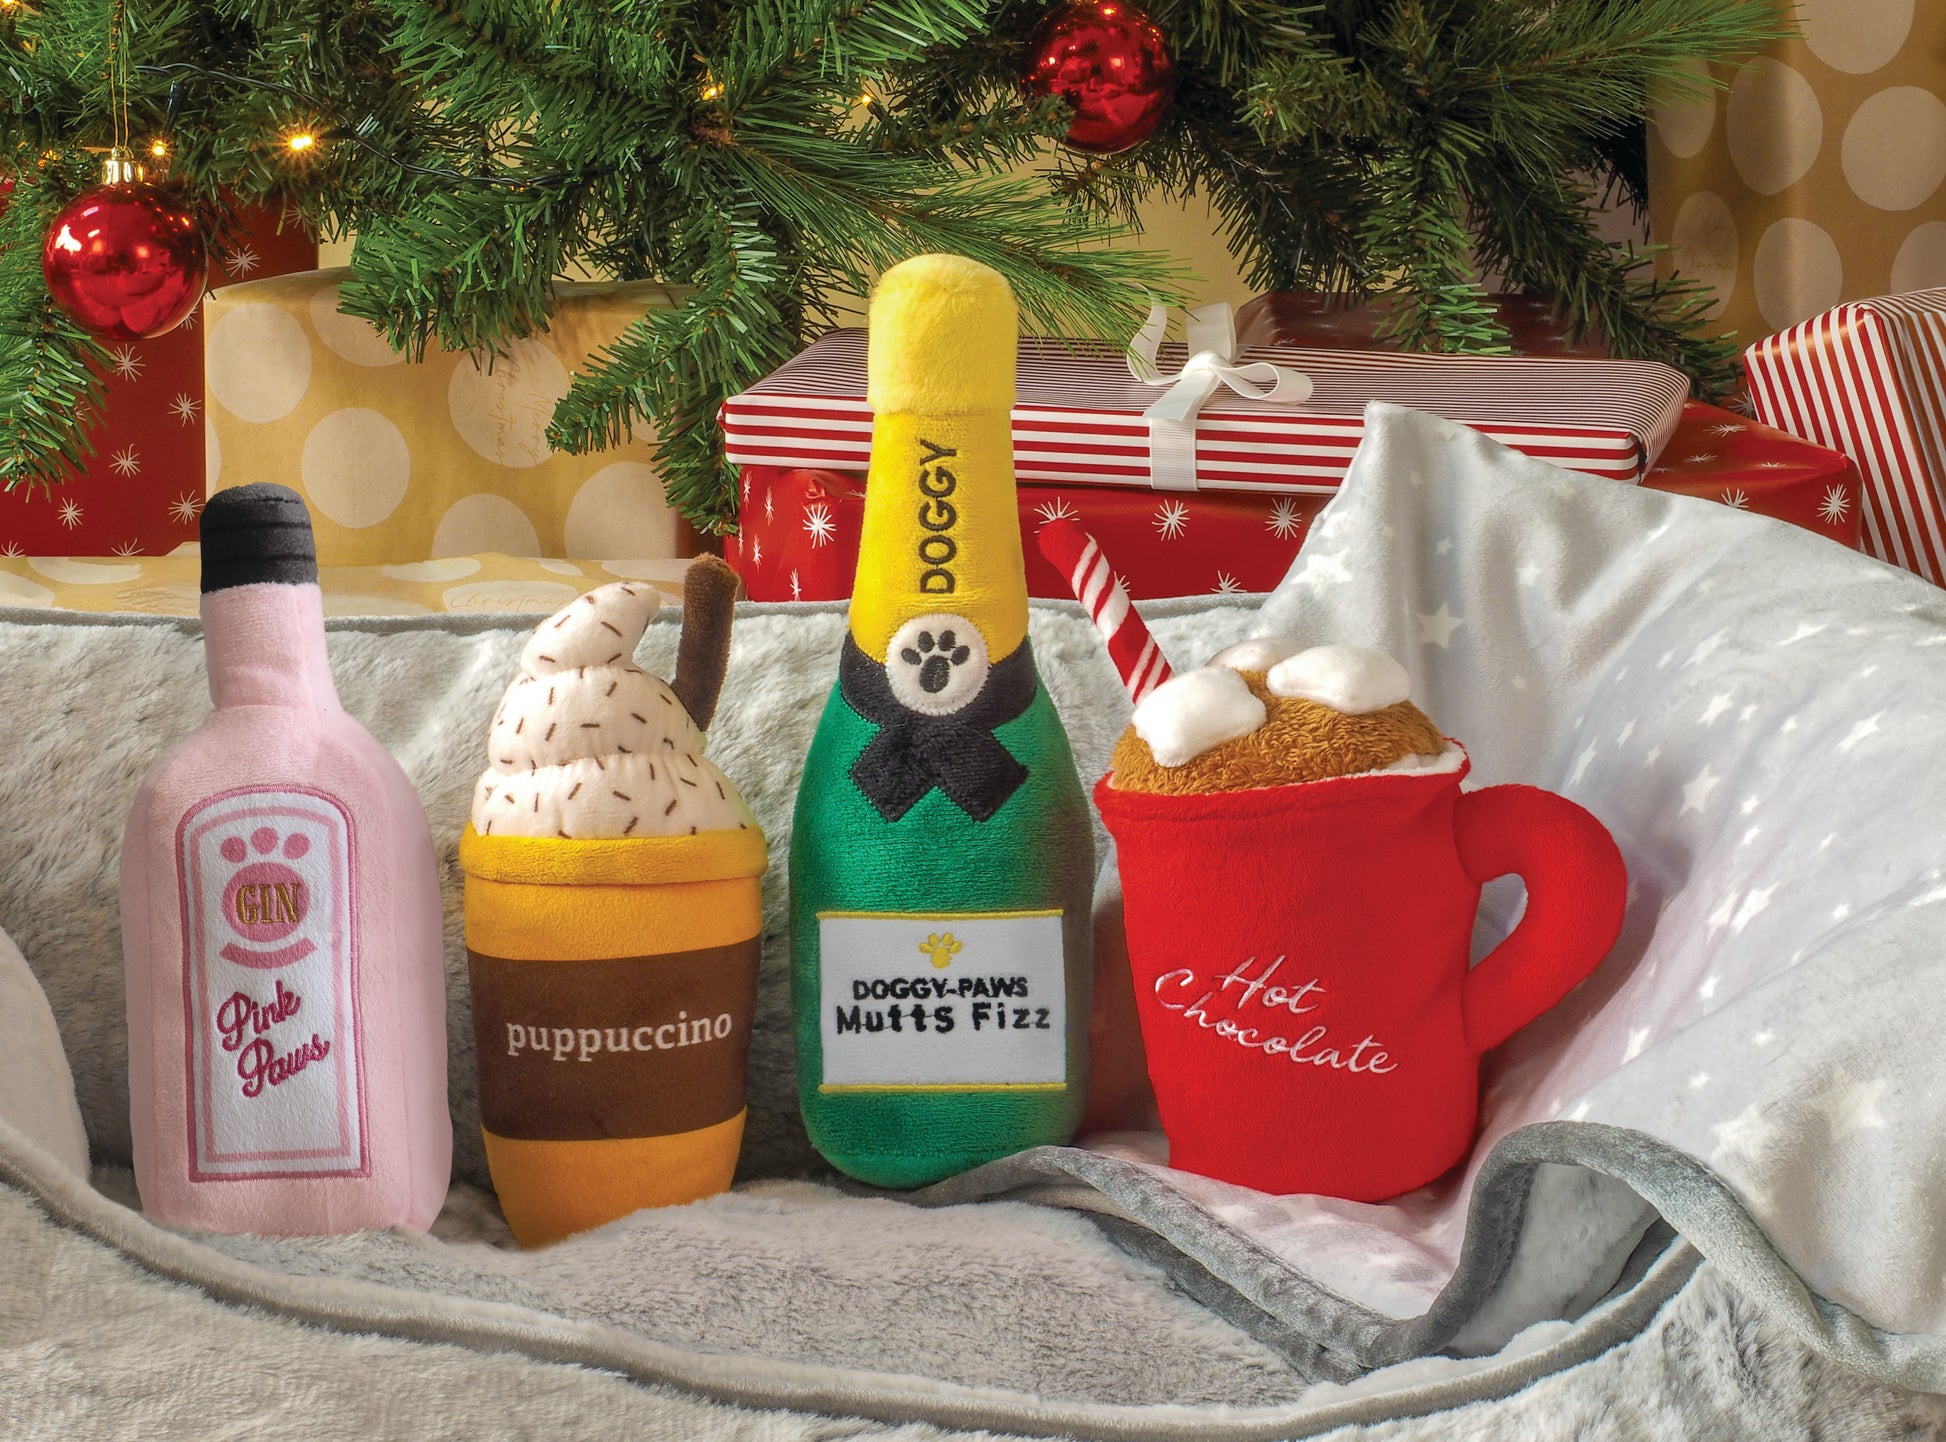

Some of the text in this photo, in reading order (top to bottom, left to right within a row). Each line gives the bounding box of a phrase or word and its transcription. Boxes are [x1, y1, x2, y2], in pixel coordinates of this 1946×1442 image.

[918, 438, 957, 594] DOGGY
[235, 883, 299, 925] GIN
[852, 976, 1029, 1001] DOGGY-PAWS
[1215, 954, 1327, 1014] Hot
[216, 979, 301, 1052] Pink
[506, 1010, 733, 1063] puppuccino
[836, 1001, 1051, 1035] Mutts Fizz
[1154, 967, 1399, 1074] Chocolate
[236, 1032, 331, 1098] Paws
